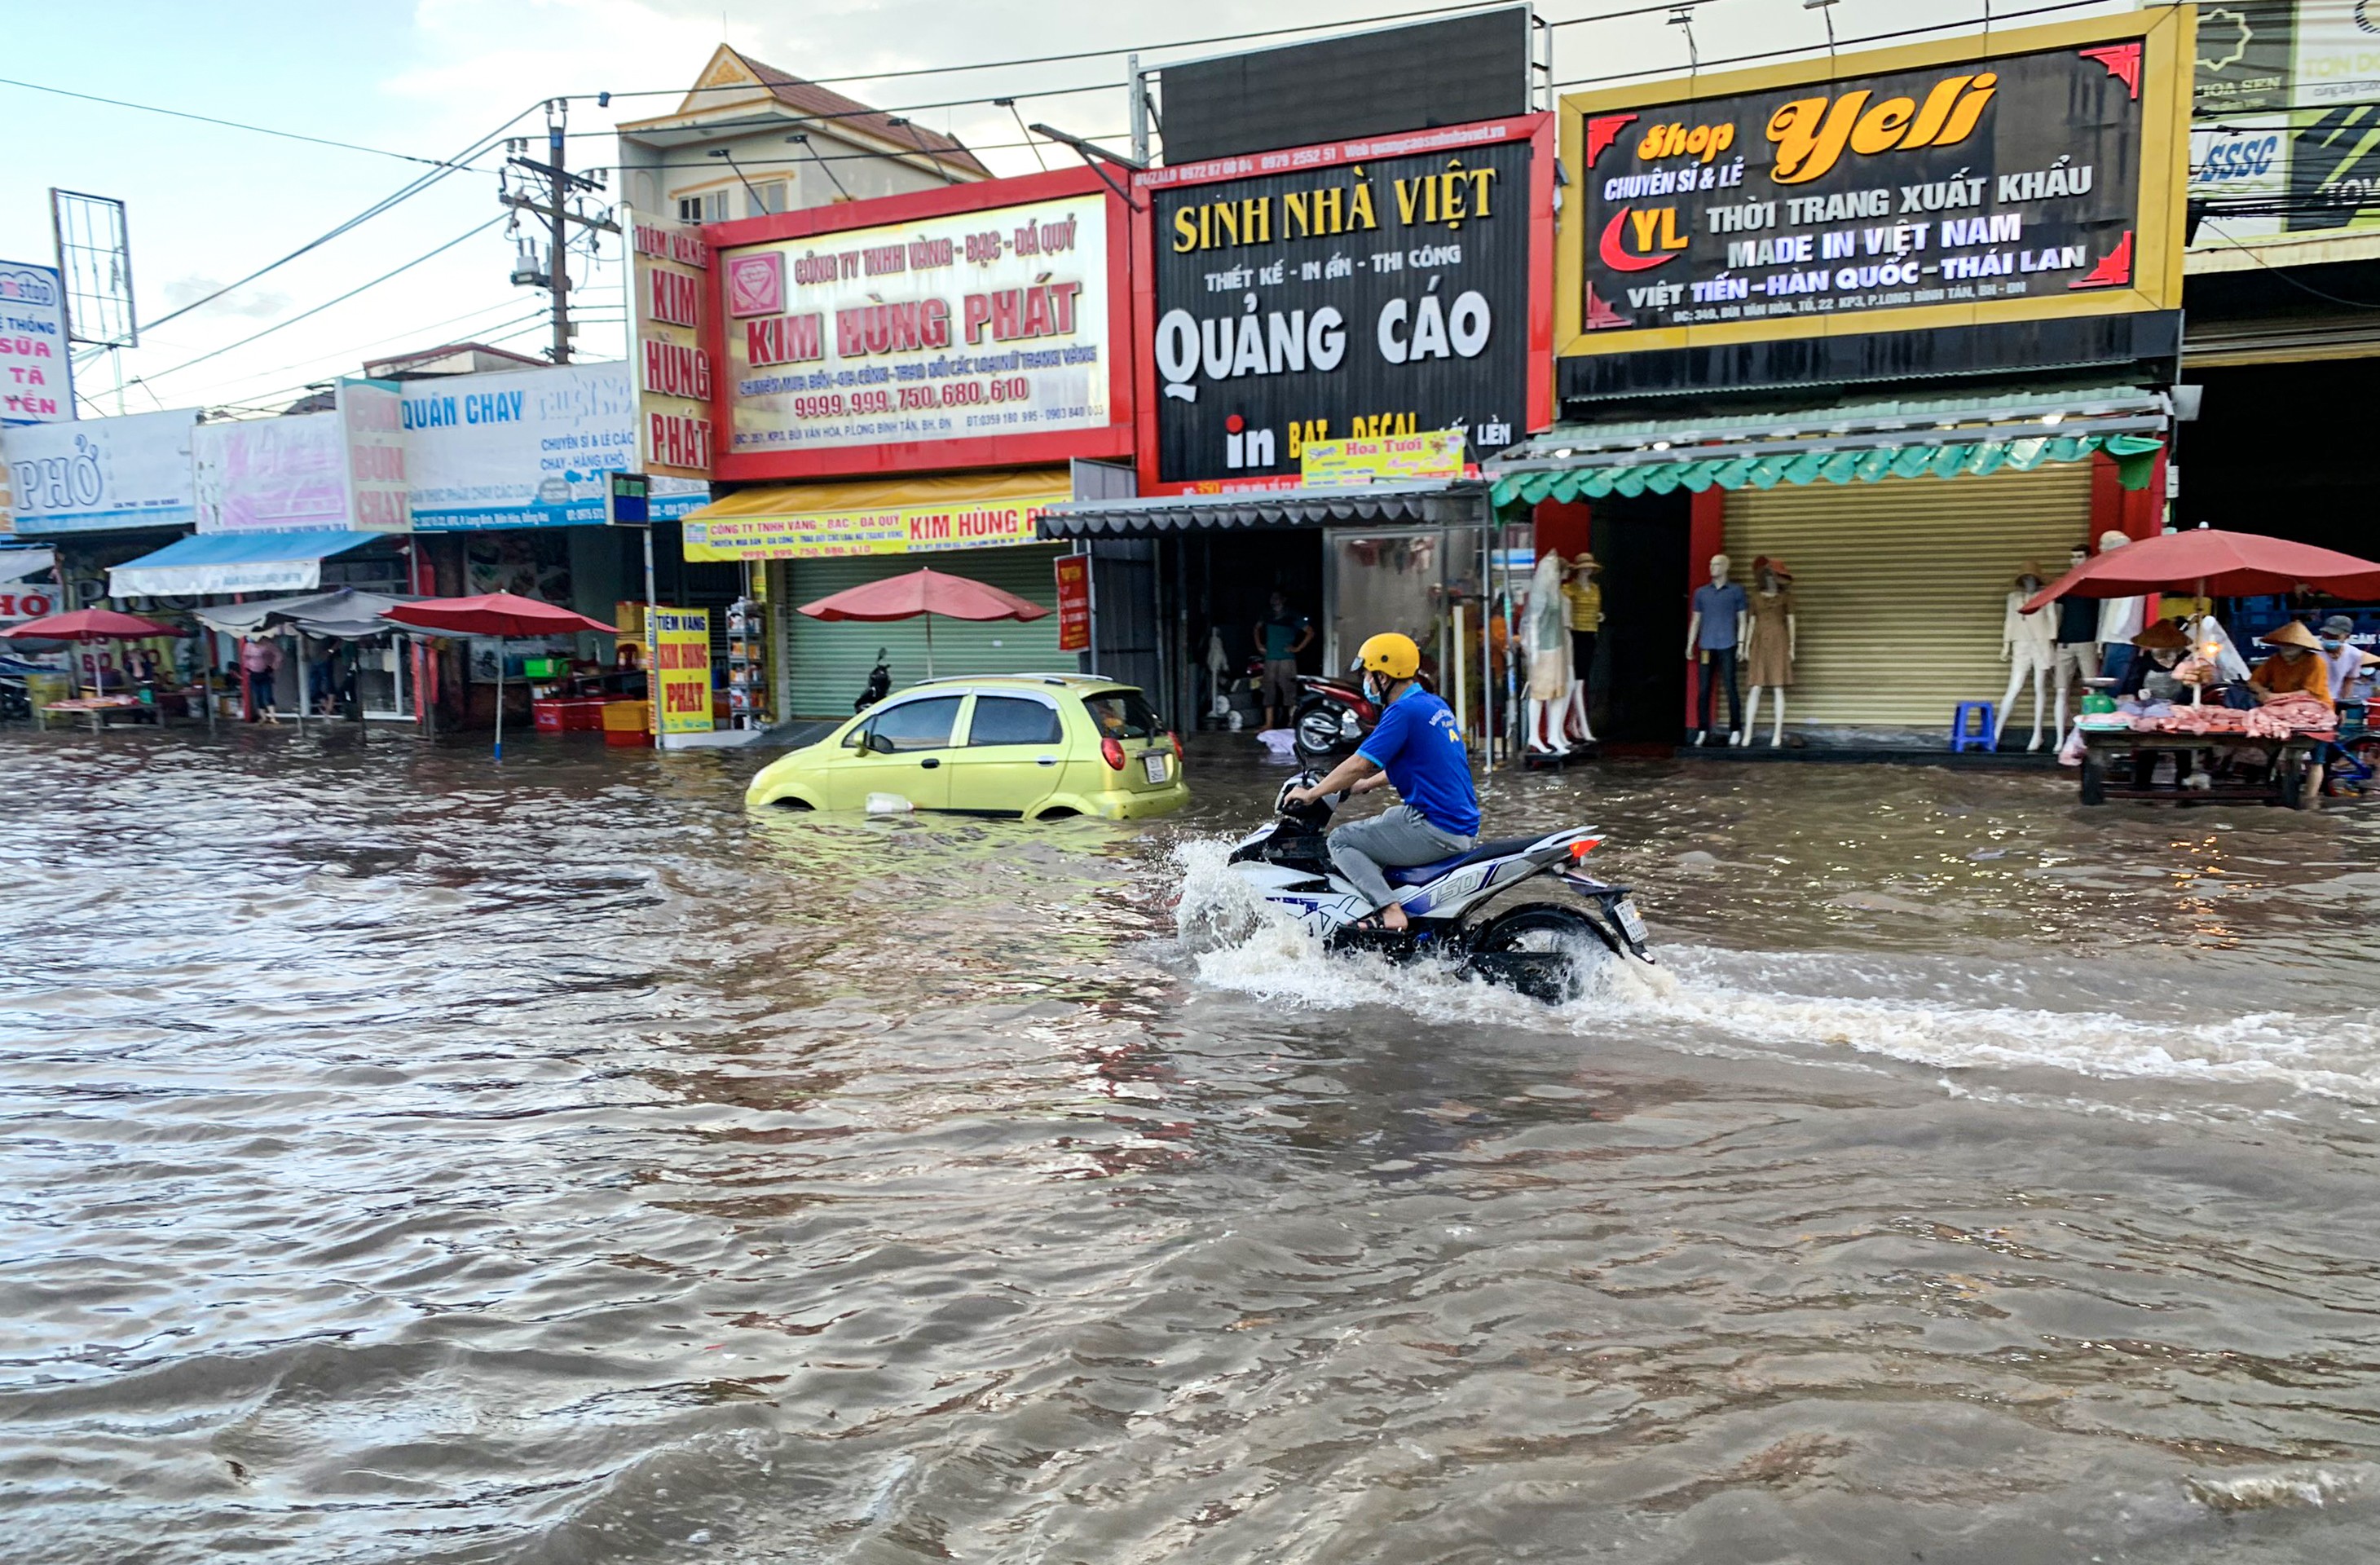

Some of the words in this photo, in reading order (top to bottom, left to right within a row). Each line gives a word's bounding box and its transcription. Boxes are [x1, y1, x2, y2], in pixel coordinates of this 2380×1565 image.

[1637, 122, 1734, 163] Shop
[1766, 72, 1998, 184] Yeli
[1603, 167, 1676, 201] CHUYÊN
[1677, 161, 1699, 192] SỈ
[1699, 168, 1716, 191] &
[1719, 156, 1746, 189] LẺ
[2202, 136, 2277, 181] SSSC
[1174, 196, 1271, 253] SINH
[1284, 165, 1377, 239] NHÀ
[1394, 159, 1497, 230] VIỆT
[1706, 196, 1776, 233] THỜI
[1787, 189, 1890, 226] TRANG
[1899, 166, 1987, 214] XUẤT
[1998, 154, 2092, 203] KHẨU
[796, 249, 838, 285] CÔNG
[838, 251, 860, 280] TY
[862, 245, 906, 277] TNHH
[909, 235, 954, 271] VÀNG
[965, 230, 1002, 267] BẠC
[1015, 218, 1040, 257] ĐÁ
[1042, 213, 1077, 256] QUÝ
[1728, 234, 1814, 270] MADE
[1822, 230, 1856, 260] IN
[1864, 218, 1930, 257] VIỆT
[1941, 213, 2022, 249] NAM
[1205, 263, 1254, 293] THIẾT
[1259, 258, 1285, 286] KẾ
[1302, 262, 1321, 280] IN
[1325, 252, 1352, 279] ẤN
[1372, 252, 1403, 273] THI
[1408, 245, 1461, 269] CÔNG
[1627, 280, 1684, 312] VIỆT
[2020, 245, 2087, 273] LAN
[650, 268, 697, 328] KIM
[747, 312, 824, 367] KIM
[835, 293, 950, 358] HÙNG
[964, 272, 1083, 345] PHÁT
[1818, 298, 1834, 310] 22
[644, 331, 711, 401] HÙNG
[1156, 292, 1346, 403] QUẢNG
[1377, 276, 1491, 364] CÁO
[9, 364, 45, 386] TÃ
[403, 391, 457, 430] QUÁN
[466, 390, 523, 425] CHAY
[646, 408, 712, 470] PHÁT
[1225, 415, 1275, 468] in
[1346, 442, 1378, 456] Hoa
[12, 433, 103, 510] PHỞ
[743, 523, 752, 533] TY
[757, 522, 784, 533] TNHH
[910, 514, 950, 540] KIM
[959, 506, 1018, 537] HÙNG
[656, 613, 680, 633] TIỆM
[681, 613, 707, 631] VÀNG
[666, 675, 704, 713] PHÁT
[1428, 870, 1479, 908] 150
